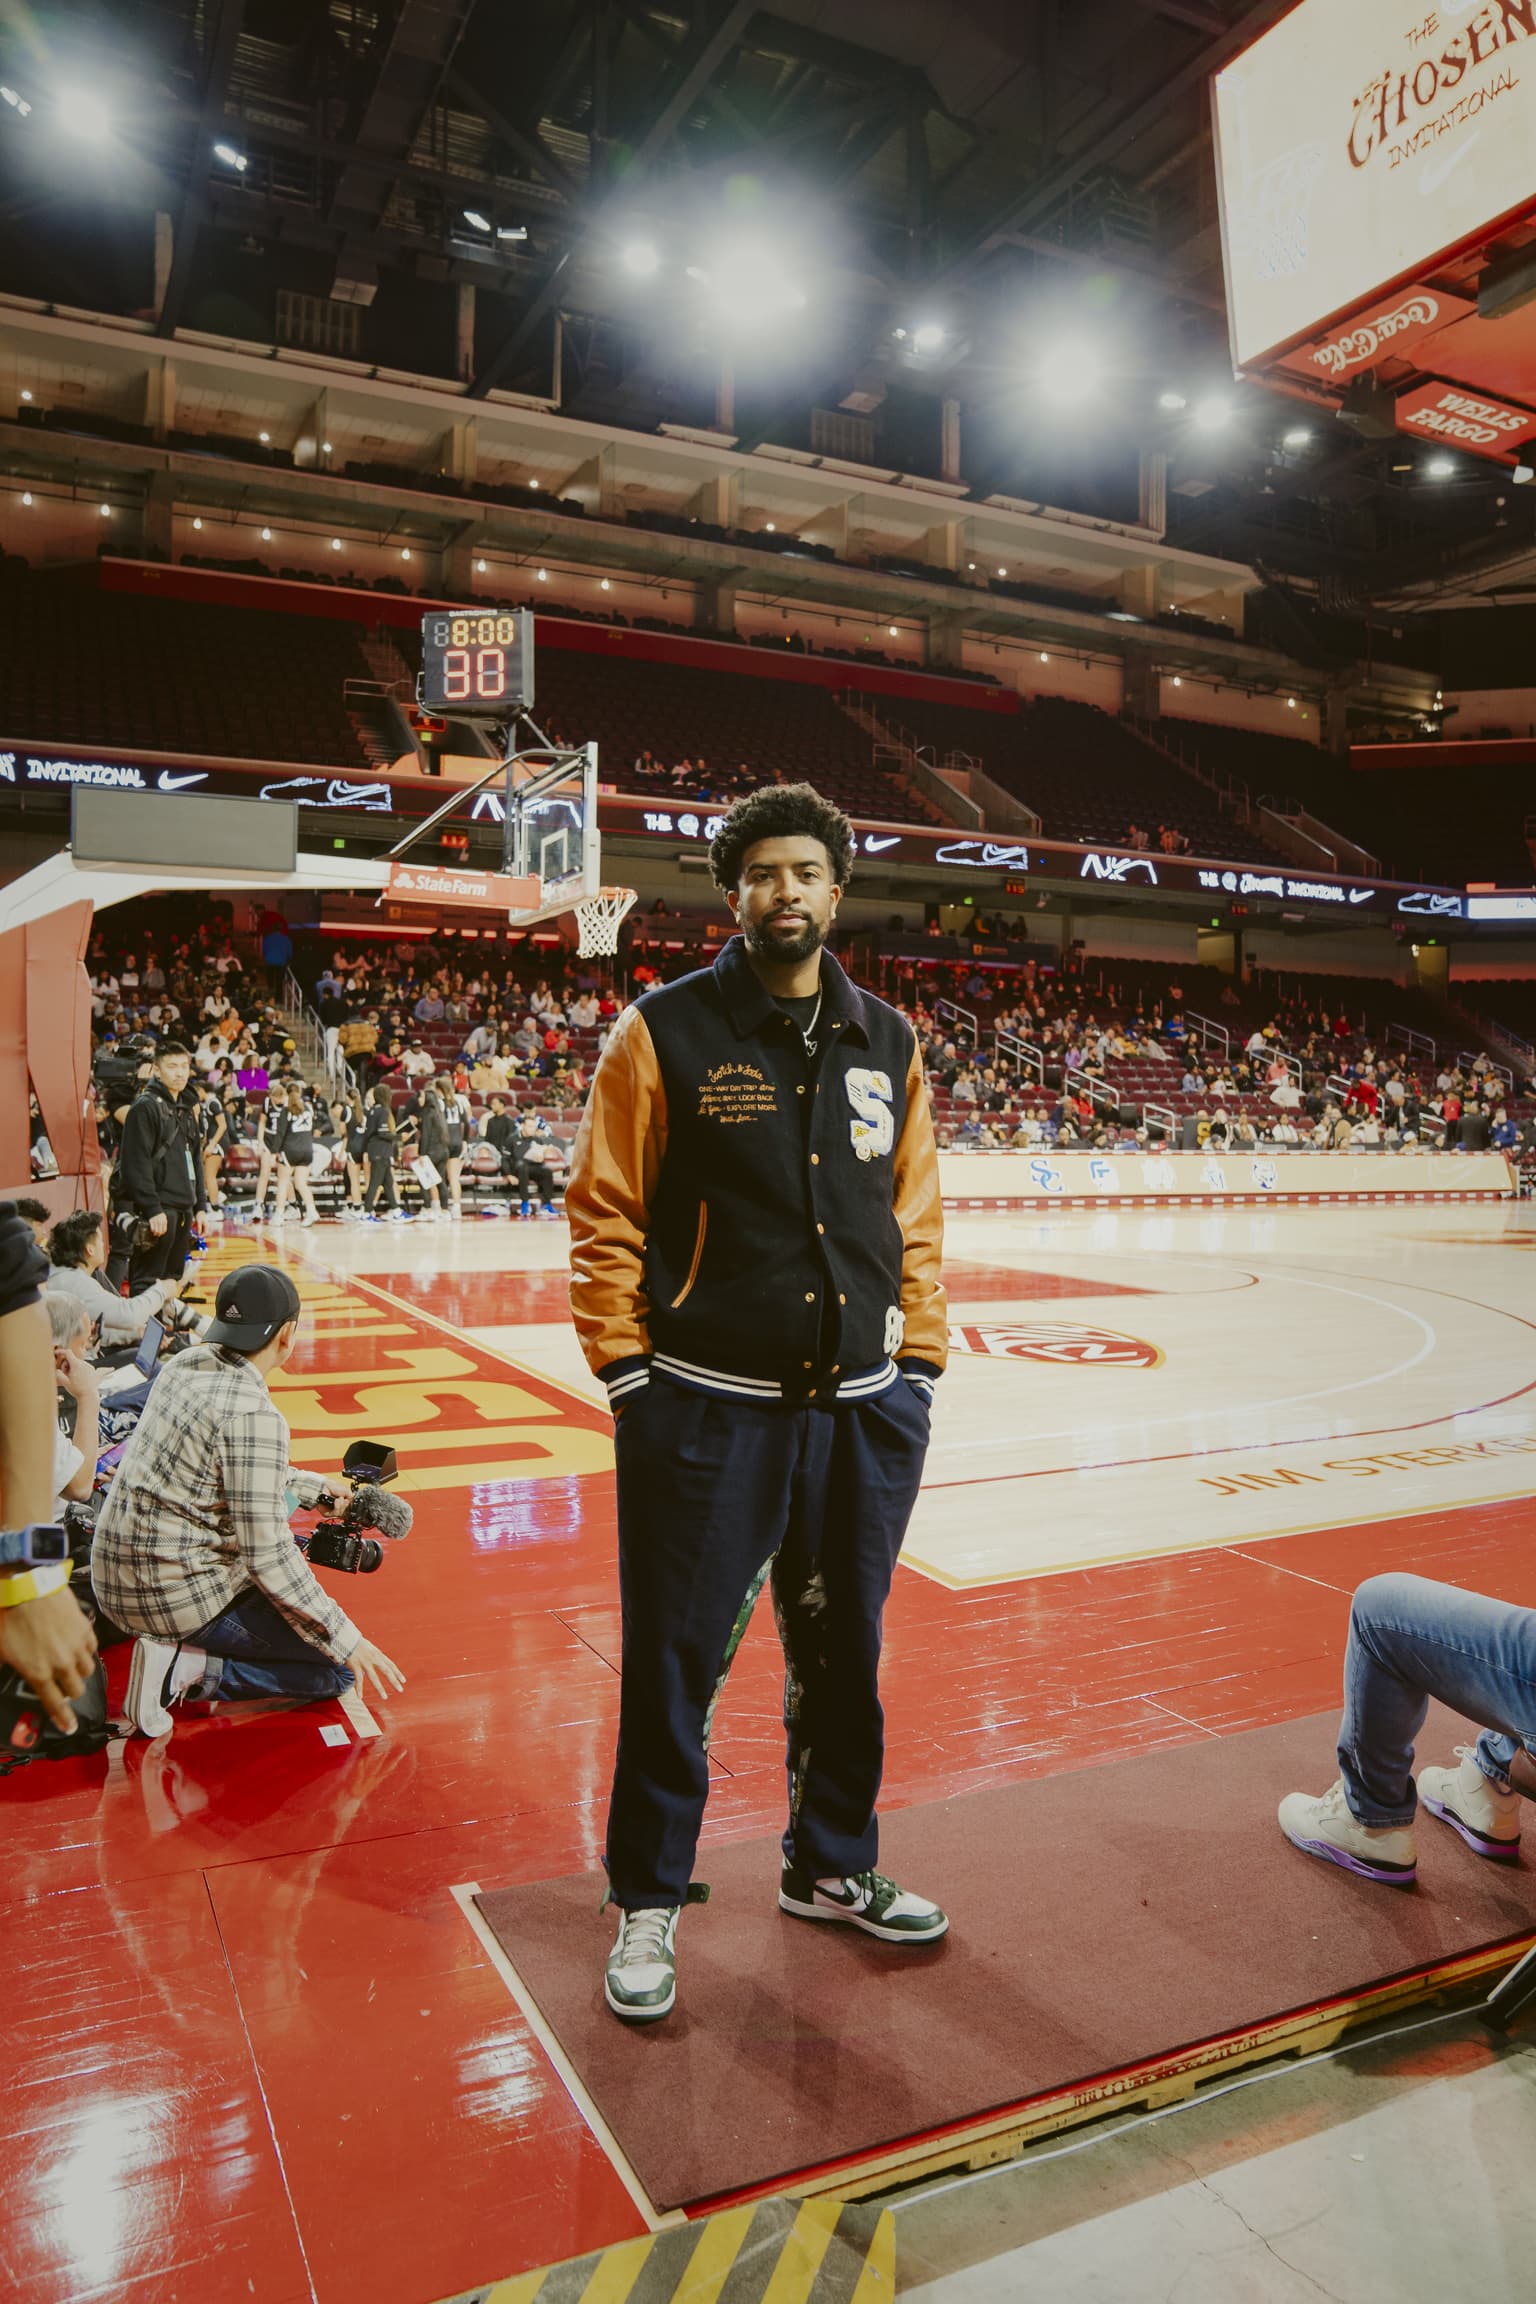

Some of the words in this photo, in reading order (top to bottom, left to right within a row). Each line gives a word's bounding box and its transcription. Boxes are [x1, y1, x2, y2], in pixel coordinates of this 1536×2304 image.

[1404, 12, 1440, 49] THE
[1347, 0, 1536, 168] CHOSEN
[1388, 66, 1520, 169] INVITATIONAL
[1405, 407, 1498, 443] FARGO
[1436, 393, 1529, 431] WELLS
[444, 649, 505, 698] 30
[643, 812, 673, 832] THE
[1198, 1468, 1328, 1496] JIM
